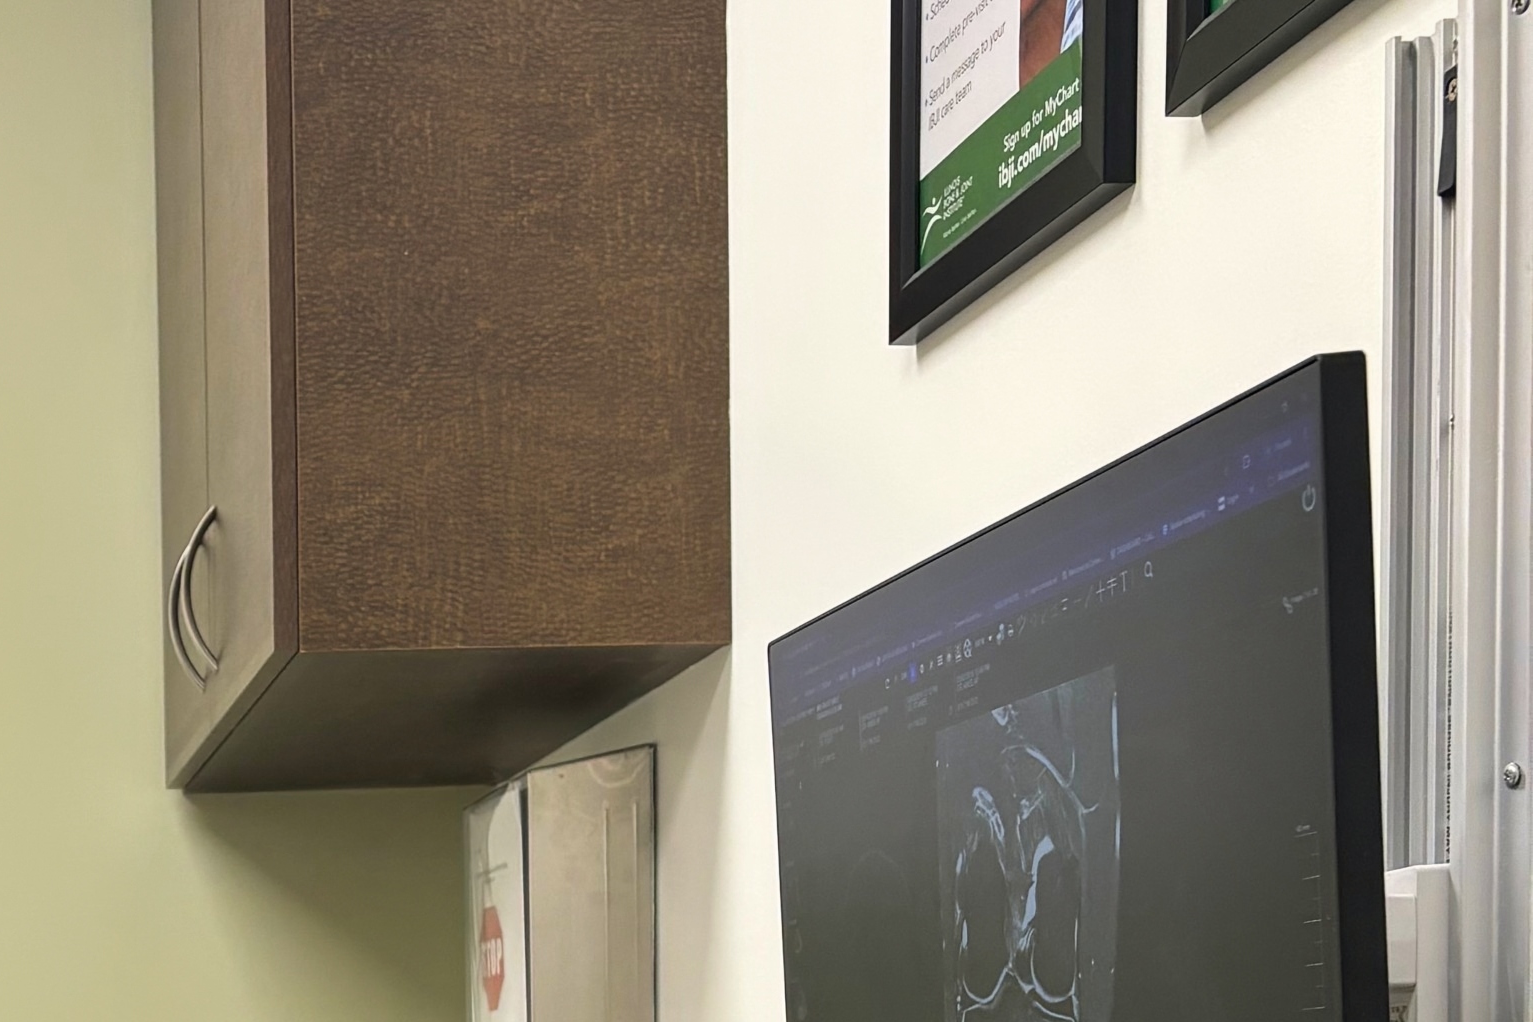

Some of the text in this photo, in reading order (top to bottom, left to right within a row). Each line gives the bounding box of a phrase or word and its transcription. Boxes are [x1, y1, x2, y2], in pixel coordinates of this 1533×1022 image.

[929, 75, 946, 105] Send
[951, 47, 980, 83] message
[981, 39, 988, 54] to
[989, 21, 1006, 51] your
[930, 24, 961, 62] Complete
[941, 97, 954, 119] care
[956, 80, 972, 105] team
[1003, 78, 1080, 152] Sign up for MyChart
[481, 936, 503, 978] STOP
